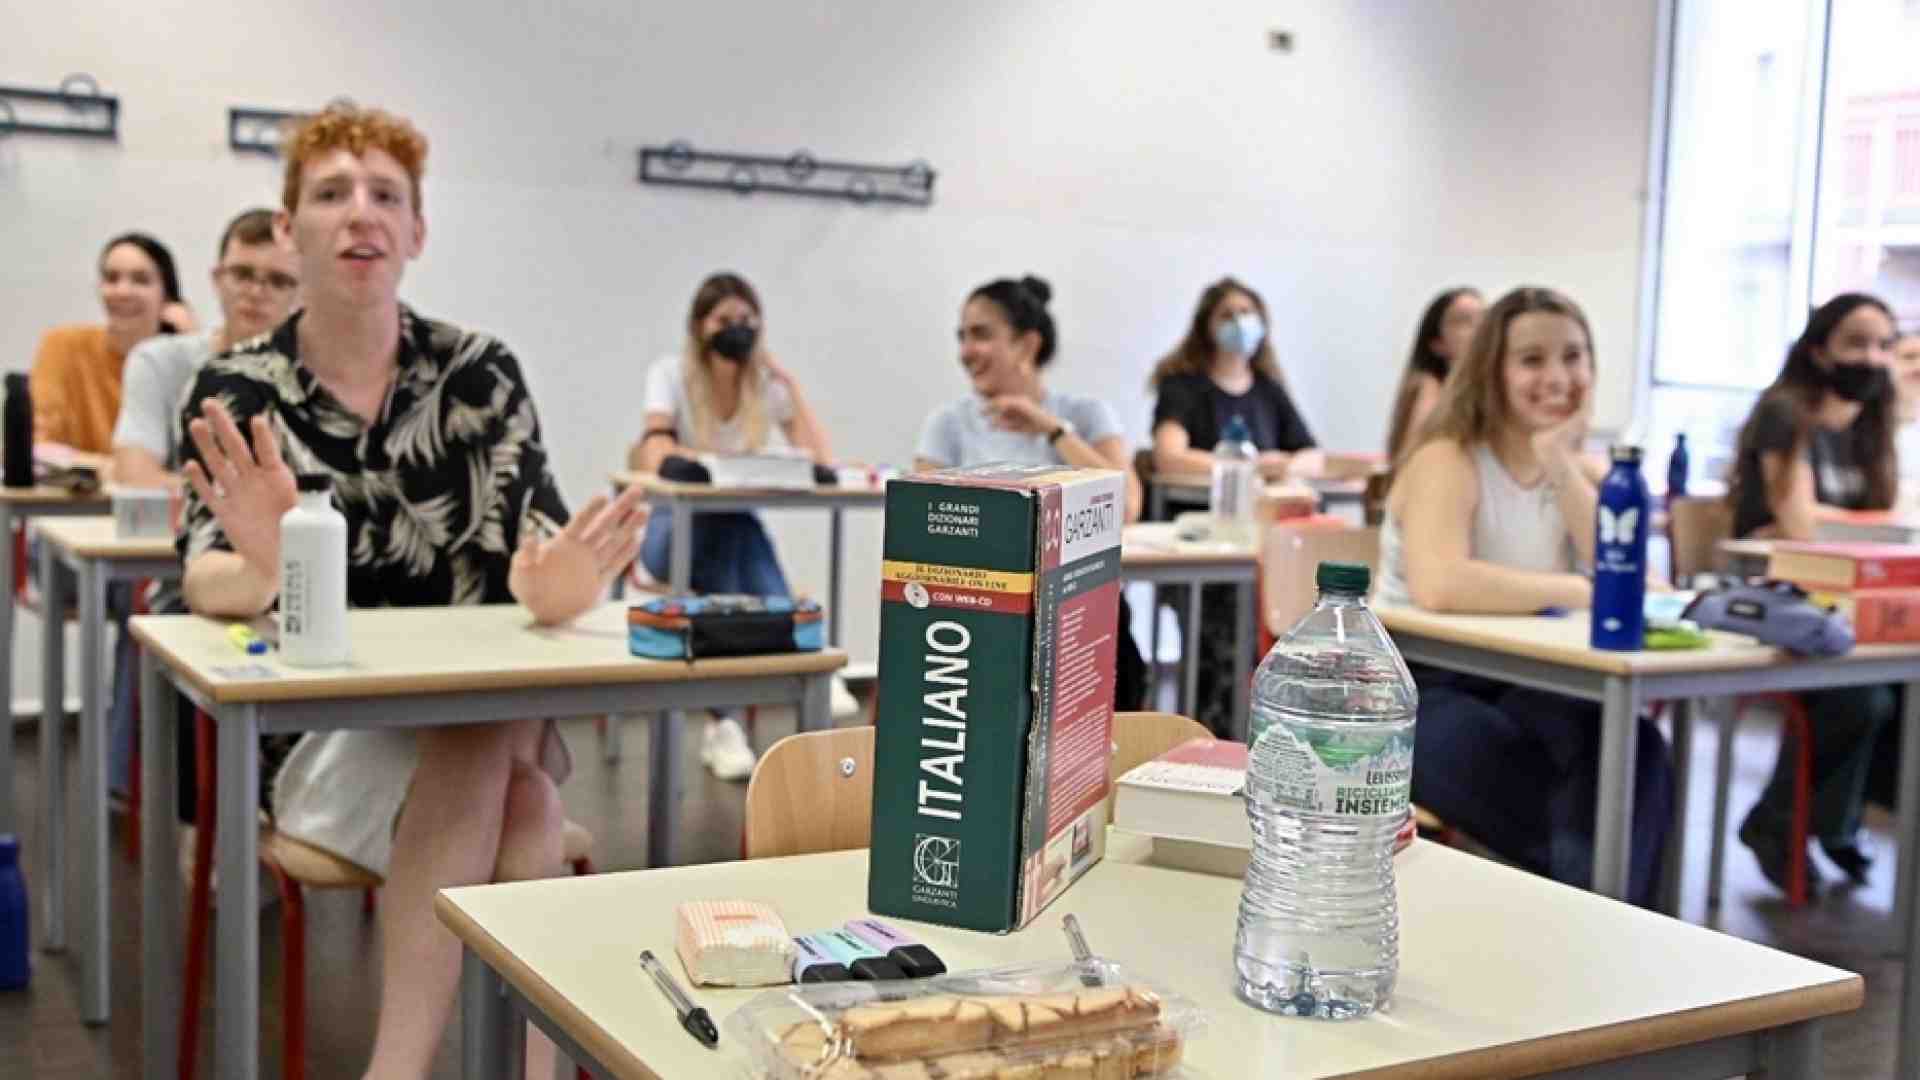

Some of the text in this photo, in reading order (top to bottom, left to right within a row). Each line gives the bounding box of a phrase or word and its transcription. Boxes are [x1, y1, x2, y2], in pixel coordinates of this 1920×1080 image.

[938, 502, 980, 515] GRANDI
[927, 512, 980, 526] DIZIONARI
[927, 525, 980, 538] GARZANTI
[931, 591, 993, 606] CON WEB-CD
[917, 620, 971, 820] ITALIANO
